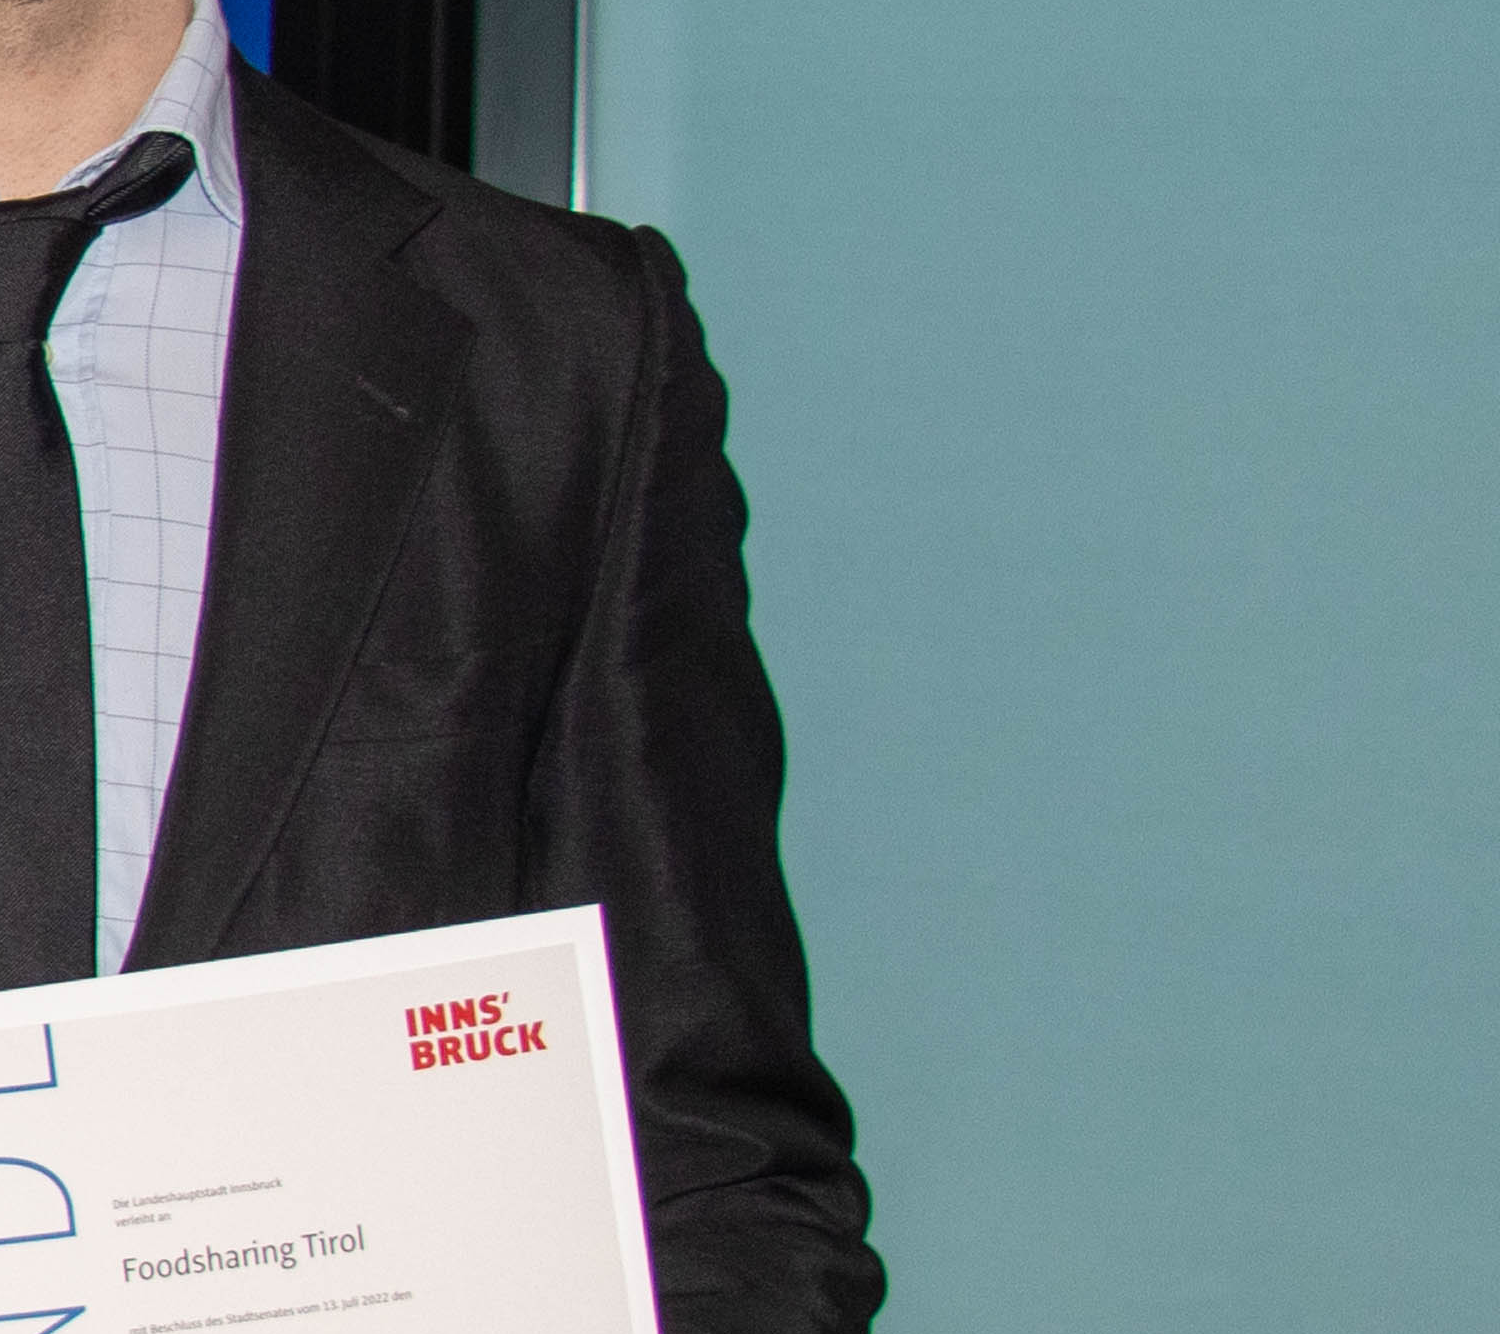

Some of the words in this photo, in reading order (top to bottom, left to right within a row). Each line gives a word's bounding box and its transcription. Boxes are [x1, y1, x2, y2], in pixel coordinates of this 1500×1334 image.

[410, 1021, 546, 1070] BRUCK
[112, 1199, 130, 1210] Die
[132, 1185, 228, 1207] Landeshauptstadt
[229, 1177, 283, 1194] Innsbruck
[115, 1213, 155, 1228] verleiht
[157, 1212, 171, 1223] an
[122, 1240, 297, 1283] Foodsharing
[301, 1224, 365, 1258] Tirol
[150, 1320, 203, 1334] Beschluss
[205, 1316, 224, 1328] des
[225, 1307, 295, 1325] Stadtsenates
[296, 1304, 321, 1315] vom
[322, 1299, 340, 1312] 13.
[341, 1296, 360, 1311] Juli
[361, 1291, 389, 1306] 2022
[391, 1290, 413, 1302] den
